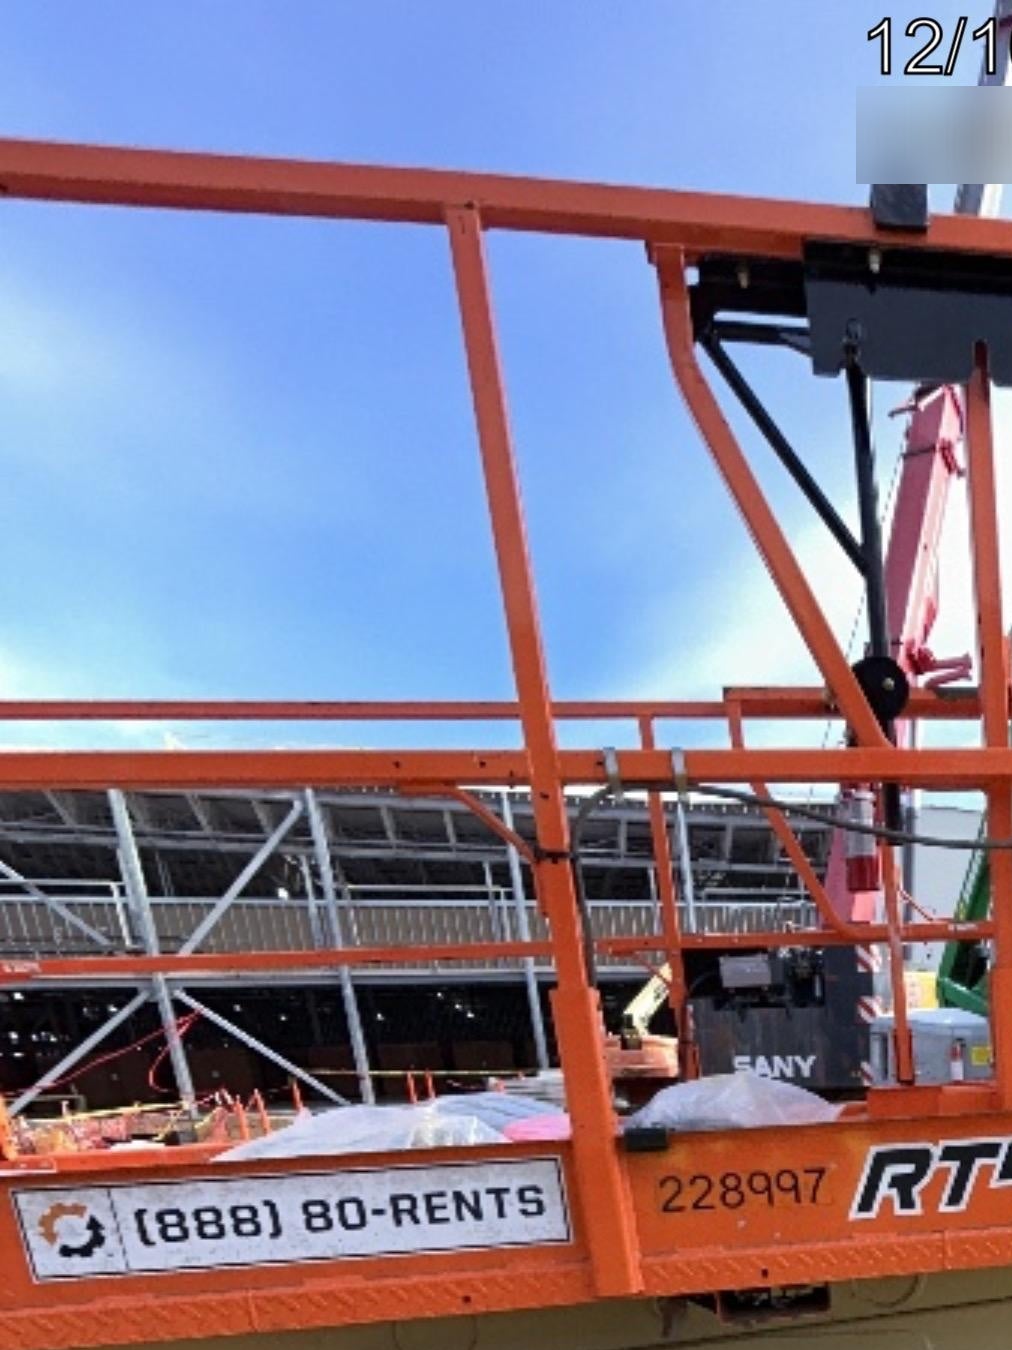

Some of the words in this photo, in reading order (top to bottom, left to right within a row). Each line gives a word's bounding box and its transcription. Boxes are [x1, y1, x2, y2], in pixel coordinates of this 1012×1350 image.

[733, 1055, 817, 1078] SANY
[658, 1167, 826, 1214] 228997
[134, 1199, 282, 1246] (888)
[302, 1185, 546, 1233] 80-RENTS
